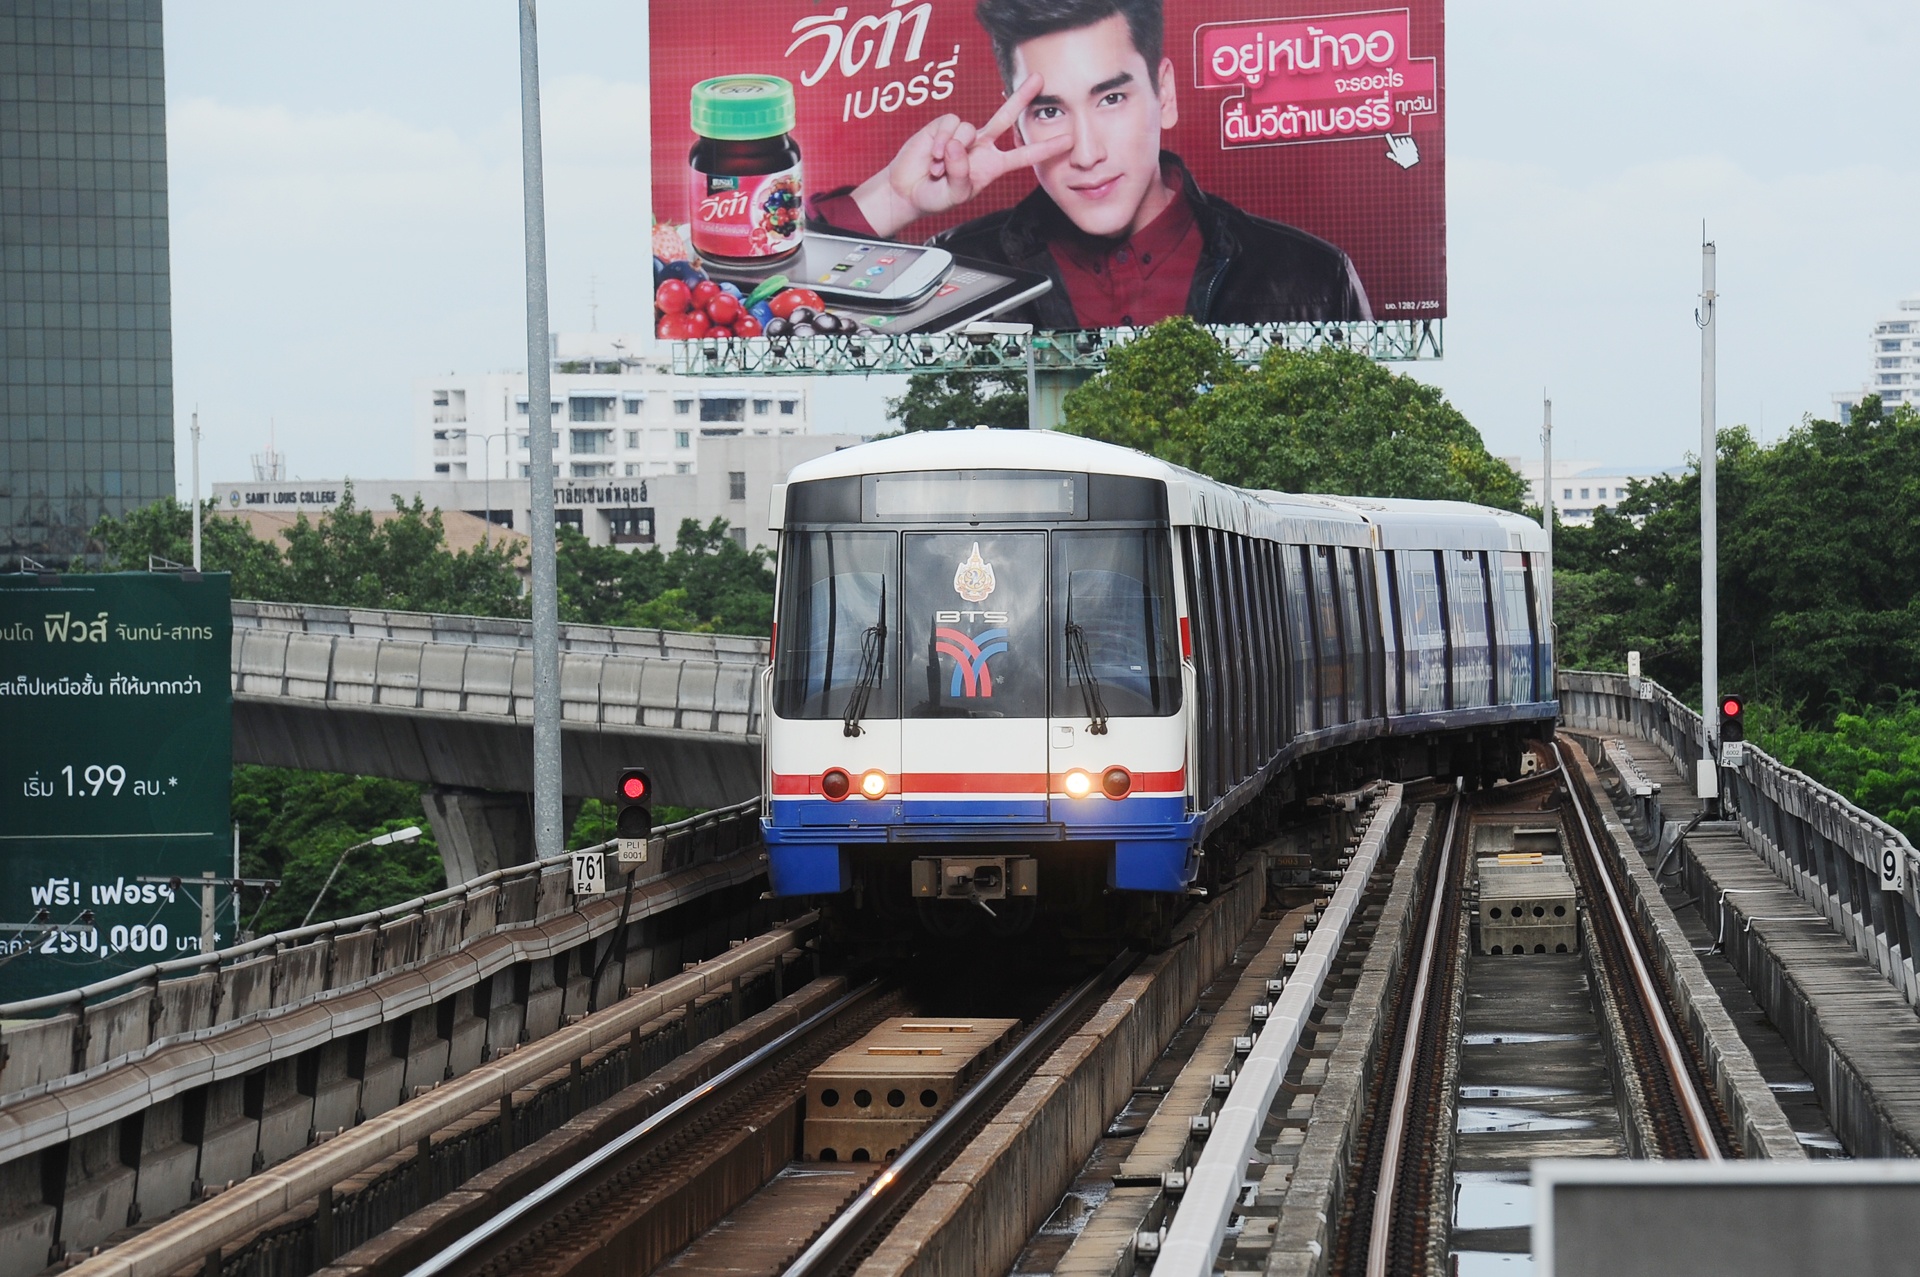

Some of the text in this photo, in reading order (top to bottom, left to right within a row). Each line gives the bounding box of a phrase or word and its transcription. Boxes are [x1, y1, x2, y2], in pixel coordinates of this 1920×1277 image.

[1211, 26, 1395, 84] อยู่หน้าจอ
[842, 44, 960, 122] เบอร์รี่
[1334, 67, 1404, 93] จะรออะไร
[1225, 90, 1433, 139] ดื่มวีต้าเบอร์รี่ ทุกวัน
[699, 191, 749, 222] วีต้า
[245, 490, 337, 504] SAINT LOUIS COLLEGE
[0, 611, 213, 643] นโด ฟิวส์ จันทน์-สาทร
[936, 610, 1008, 623] BTS
[110, 671, 202, 696] ที่ให้มากกว่า
[23, 771, 54, 797] เริ่ม
[61, 765, 126, 797] 1.99
[623, 851, 642, 860] 6001
[626, 841, 640, 849] PLI
[576, 855, 603, 881] 761
[1883, 850, 1896, 882] 9
[31, 876, 175, 906] ฟรี! เฟอรฯ
[577, 882, 593, 894] F4
[1897, 875, 1902, 888] 2
[40, 923, 168, 958] 250,000
